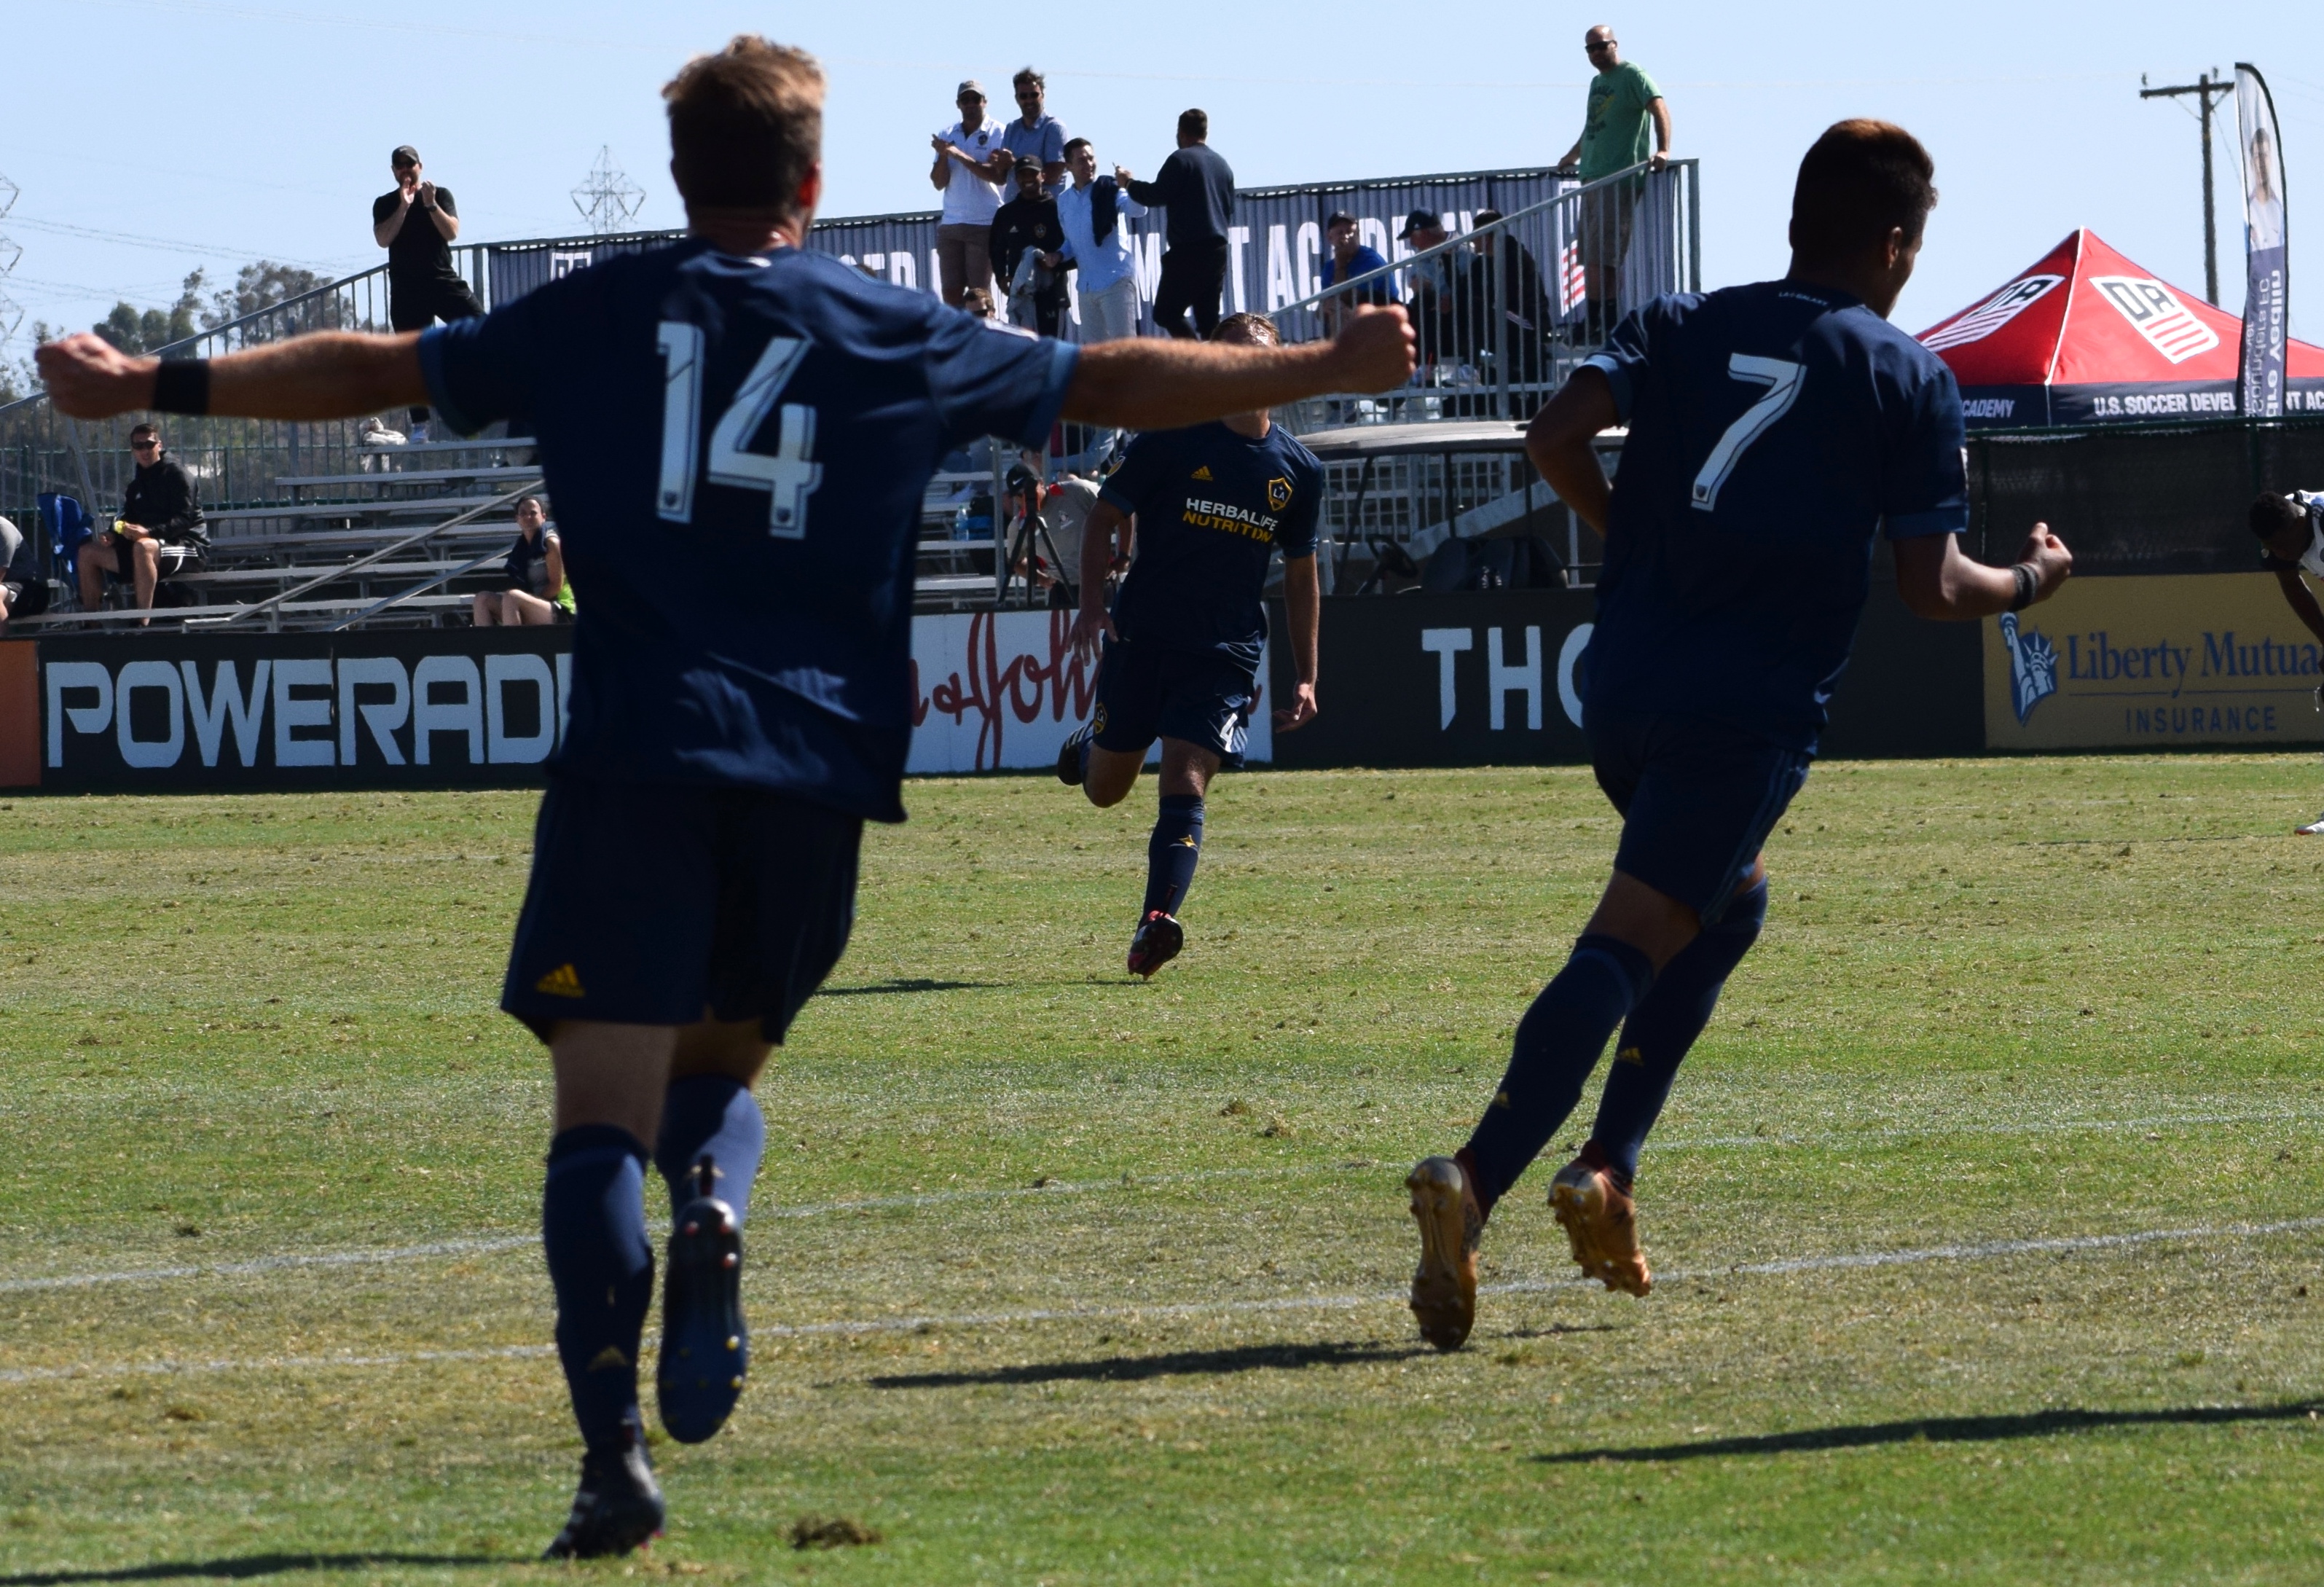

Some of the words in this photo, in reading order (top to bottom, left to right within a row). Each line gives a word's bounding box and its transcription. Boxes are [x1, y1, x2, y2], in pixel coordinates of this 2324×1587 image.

[1962, 399, 2016, 418] CADEMY
[2093, 396, 2124, 417] U.S.
[2124, 393, 2188, 415] SOCCER
[656, 321, 824, 540] 14
[1691, 352, 1807, 512] 7
[2066, 631, 2191, 698] Liberty
[2199, 631, 2321, 678] Mutua
[2125, 705, 2277, 734] INSURANCE
